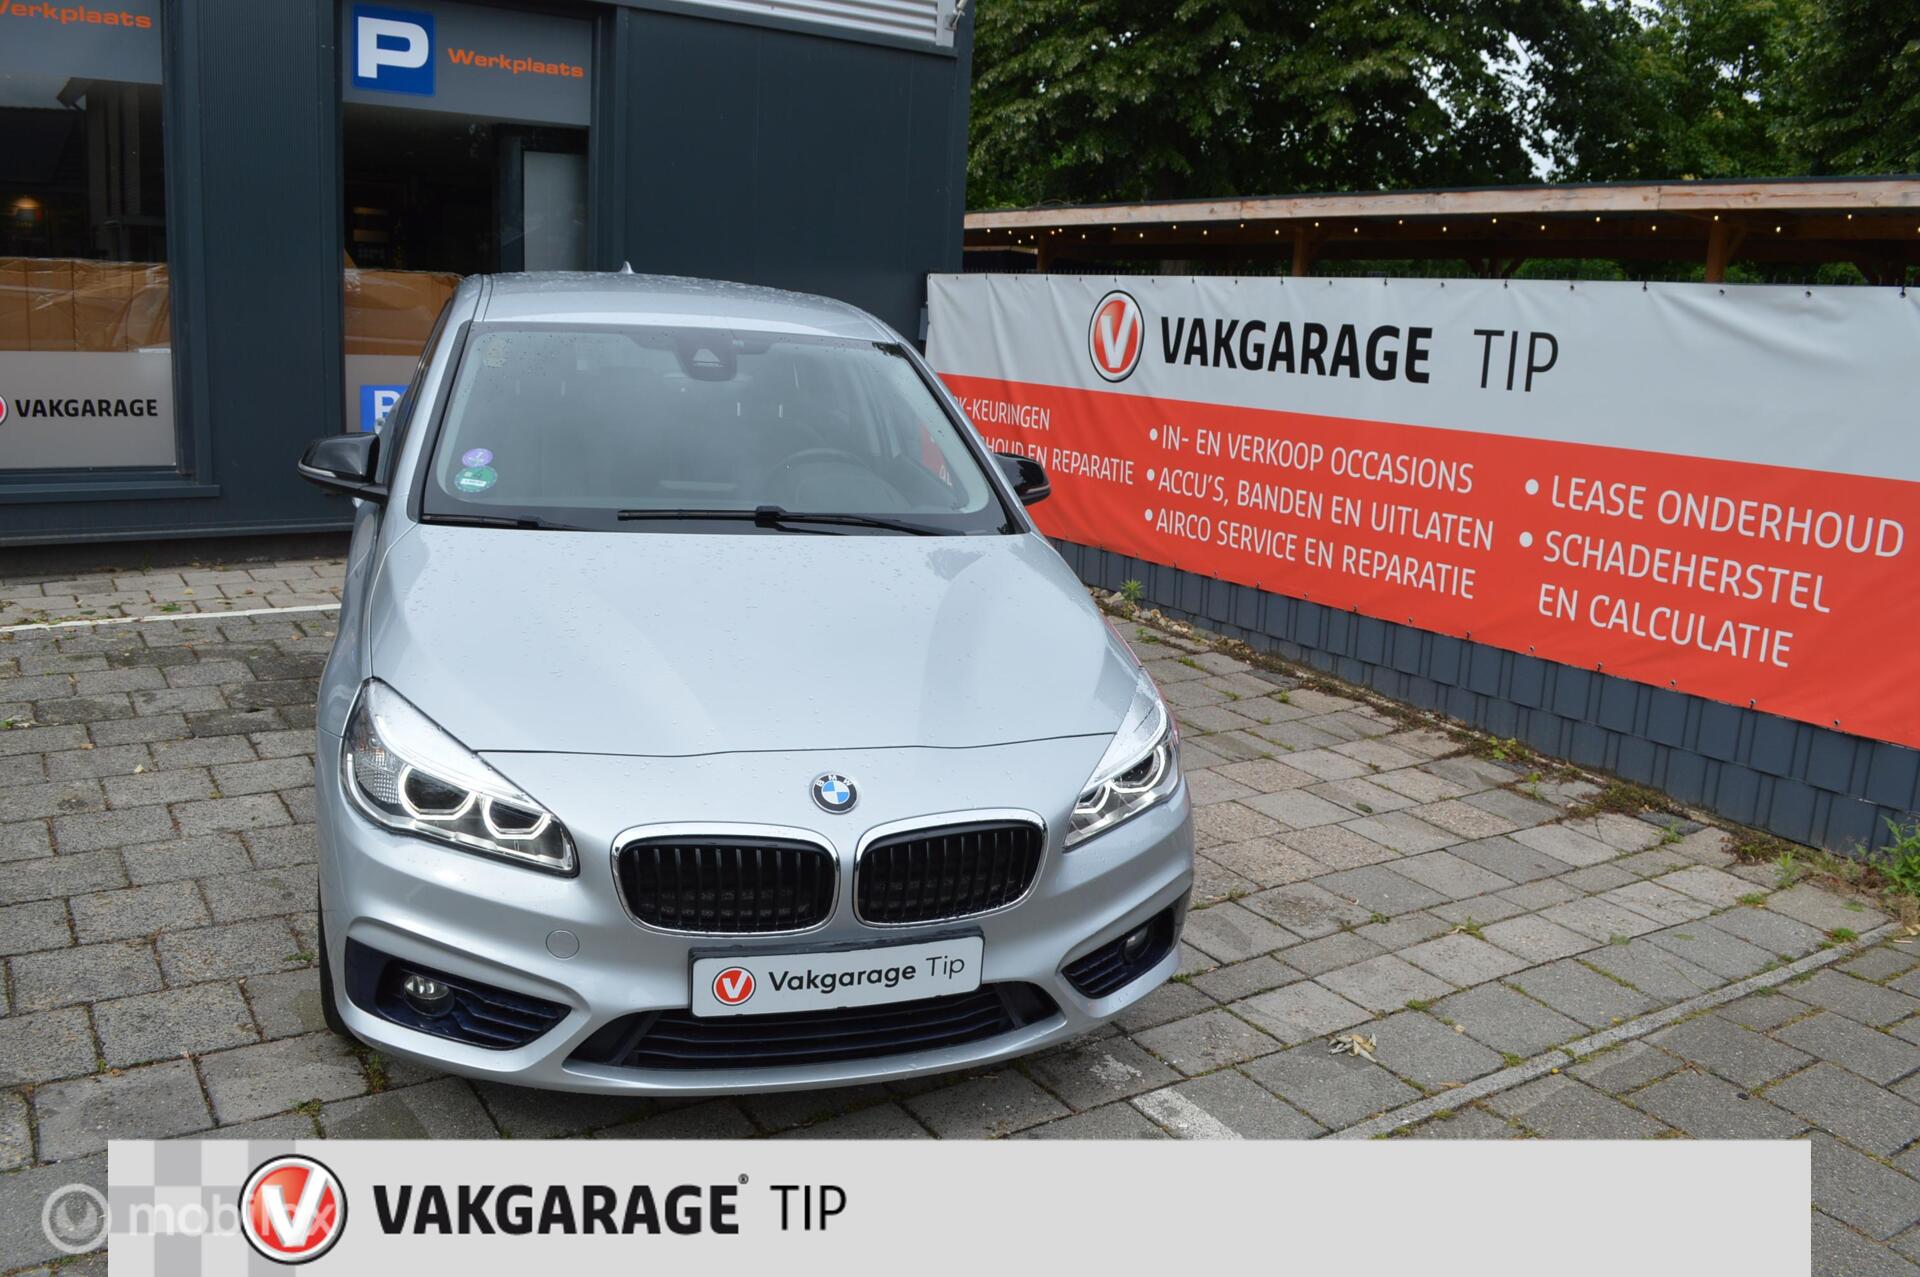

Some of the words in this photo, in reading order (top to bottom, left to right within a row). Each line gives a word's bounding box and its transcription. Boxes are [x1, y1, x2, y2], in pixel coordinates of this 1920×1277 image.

[357, 15, 430, 79] P
[447, 48, 585, 78] Werkplaats
[1160, 316, 1433, 384] VAKGARAGE
[1473, 328, 1559, 392] TIP
[15, 398, 158, 418] VAKGARAGE
[1052, 448, 1134, 485] REPARATIE
[1162, 425, 1190, 451] IN-
[1196, 429, 1221, 457] EN
[1228, 432, 1324, 471] VERKOOP
[1331, 447, 1474, 494] OCCASIONS
[1158, 467, 1229, 507] ACCU'S,
[1237, 479, 1323, 520] BANDEN
[1331, 495, 1361, 527] EN
[1371, 502, 1494, 551] UITLATEN
[1551, 475, 1646, 520] LEASE
[1657, 489, 1905, 558] ONDERHOUD
[1156, 508, 1211, 541] AIRCO
[1216, 520, 1297, 561] SERVICE
[1304, 537, 1334, 569] EN
[1342, 545, 1476, 599] REPARATIE
[1543, 530, 1830, 613] SCHADEHERSTEL
[1538, 583, 1578, 621] EN
[1589, 594, 1793, 668] CALCULATIE
[768, 964, 917, 994] Vakgarage
[926, 956, 965, 980] Tip
